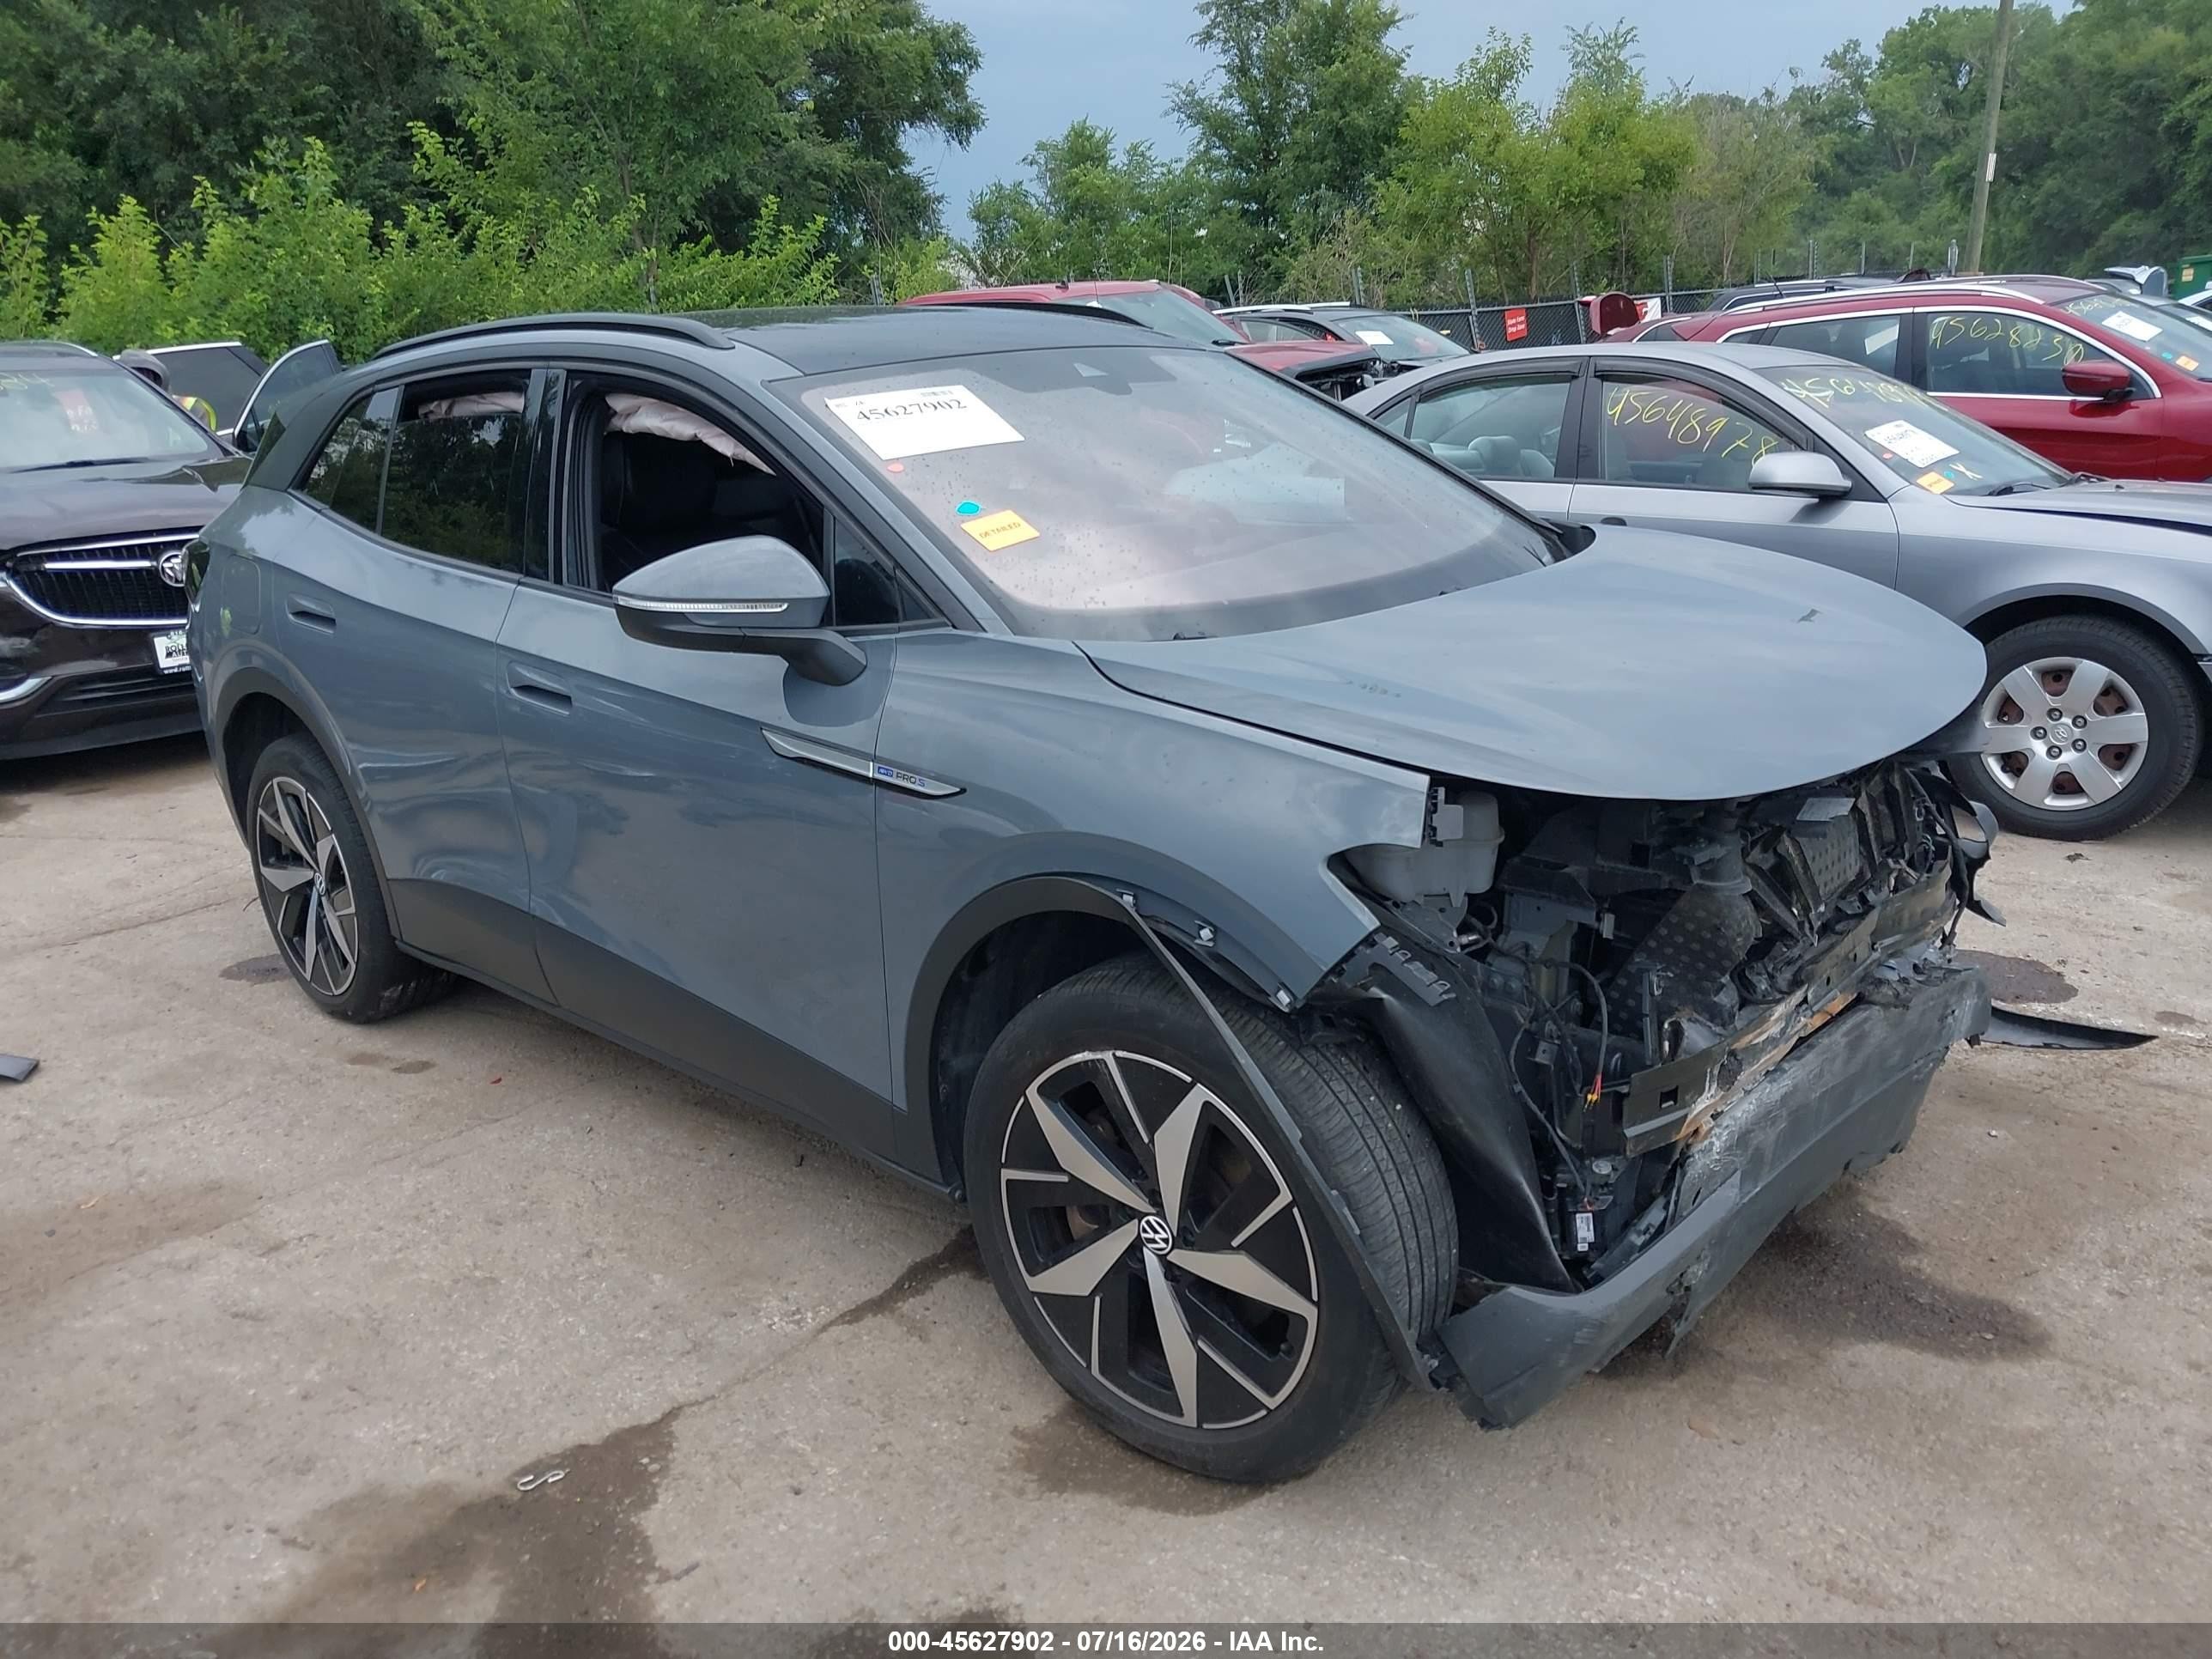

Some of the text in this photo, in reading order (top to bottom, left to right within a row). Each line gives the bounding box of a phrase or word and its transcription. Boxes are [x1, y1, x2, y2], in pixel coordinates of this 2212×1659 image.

[857, 398, 968, 421] 45627902
[979, 521, 1021, 539] DETAILED
[896, 772, 916, 784] PRO
[917, 778, 926, 787] S
